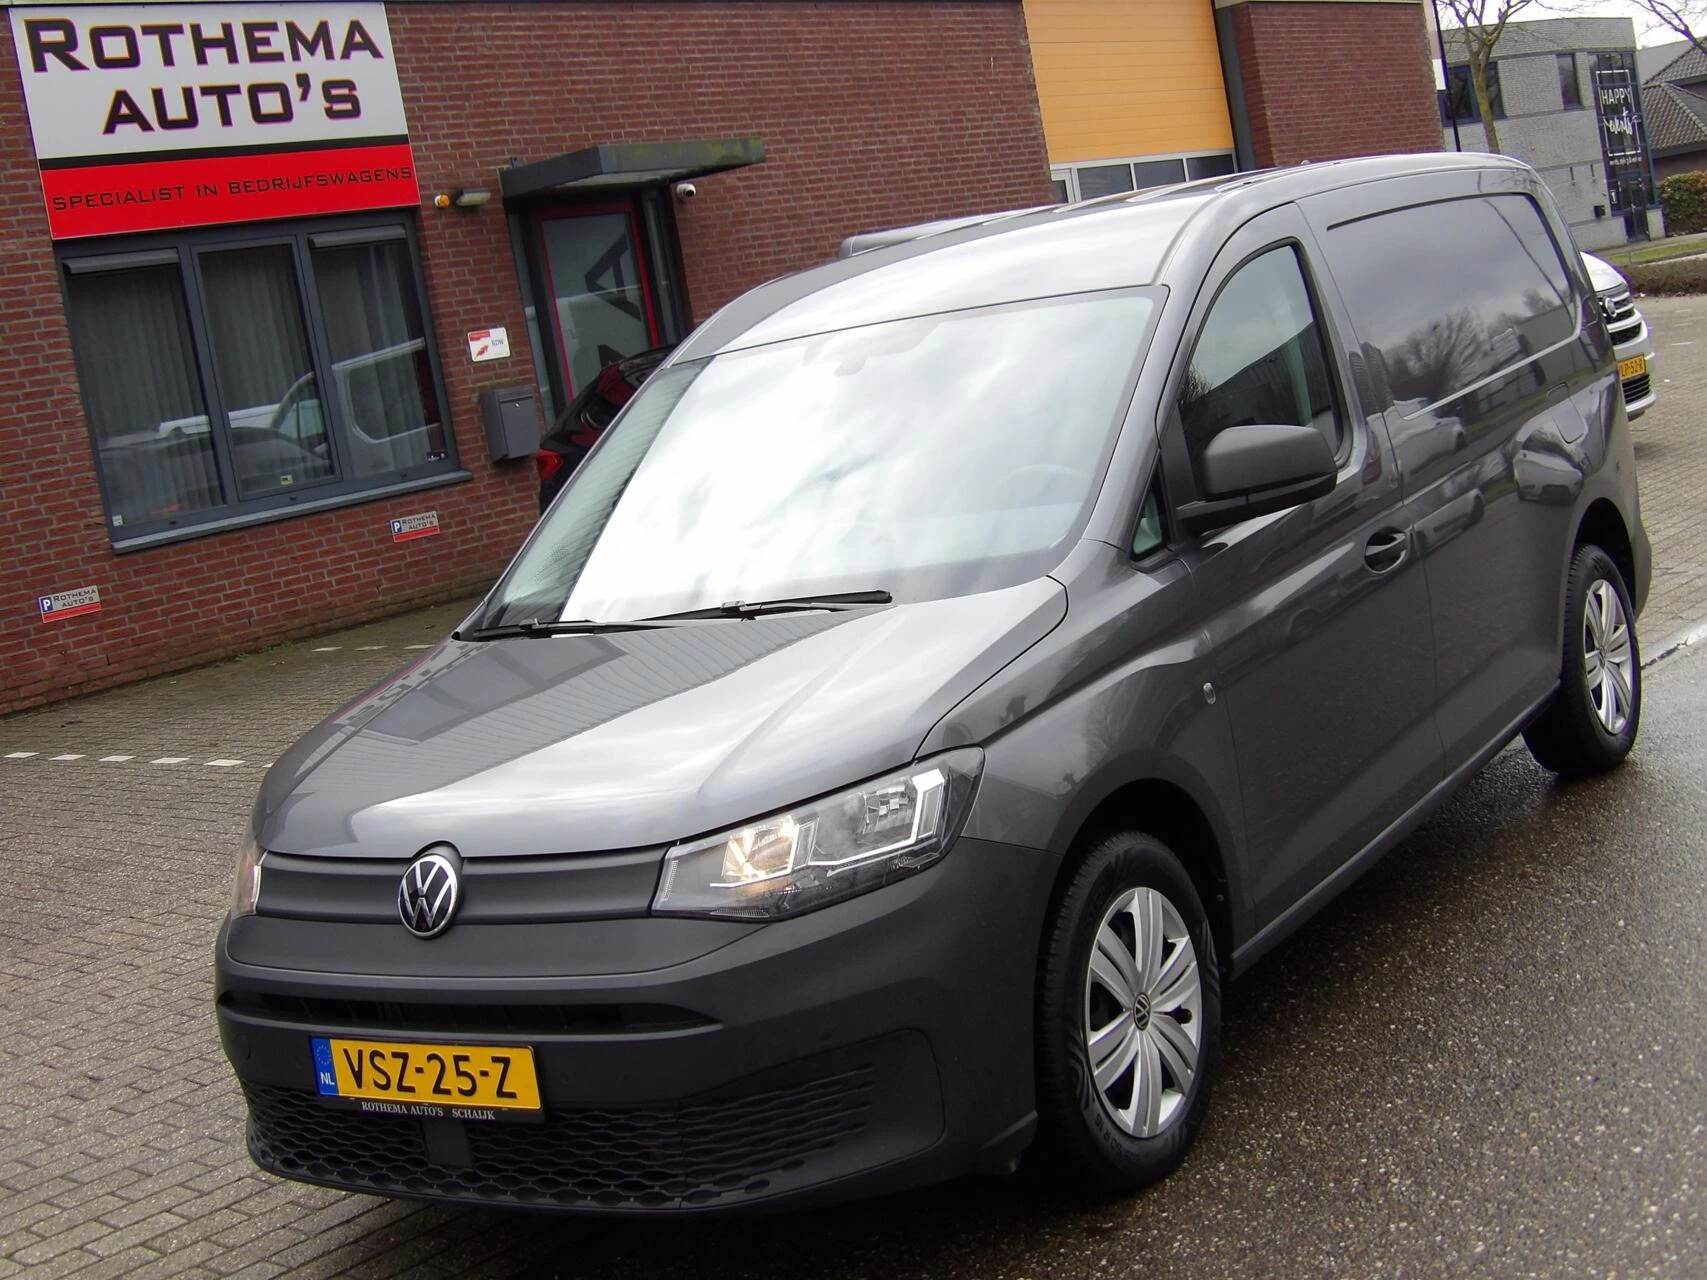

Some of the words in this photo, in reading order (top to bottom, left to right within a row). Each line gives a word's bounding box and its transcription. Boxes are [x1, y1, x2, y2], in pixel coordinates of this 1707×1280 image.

[23, 17, 385, 73] ROTHEMA
[102, 72, 362, 135] AUTO'S
[1601, 88, 1631, 105] HAPPY
[52, 186, 185, 211] SPECIALIST
[197, 183, 218, 199] IN
[228, 166, 412, 196] BEDRIJFSWAGENS
[401, 514, 436, 524] ROTHEMA
[53, 589, 97, 602] ROTHEMA
[320, 1071, 336, 1086] NL
[342, 1047, 518, 1099] VSZ-25-Z
[361, 1101, 408, 1114] ROTHEMA
[409, 1104, 444, 1117] AUTO'S
[451, 1107, 496, 1121] SCHAIJK
